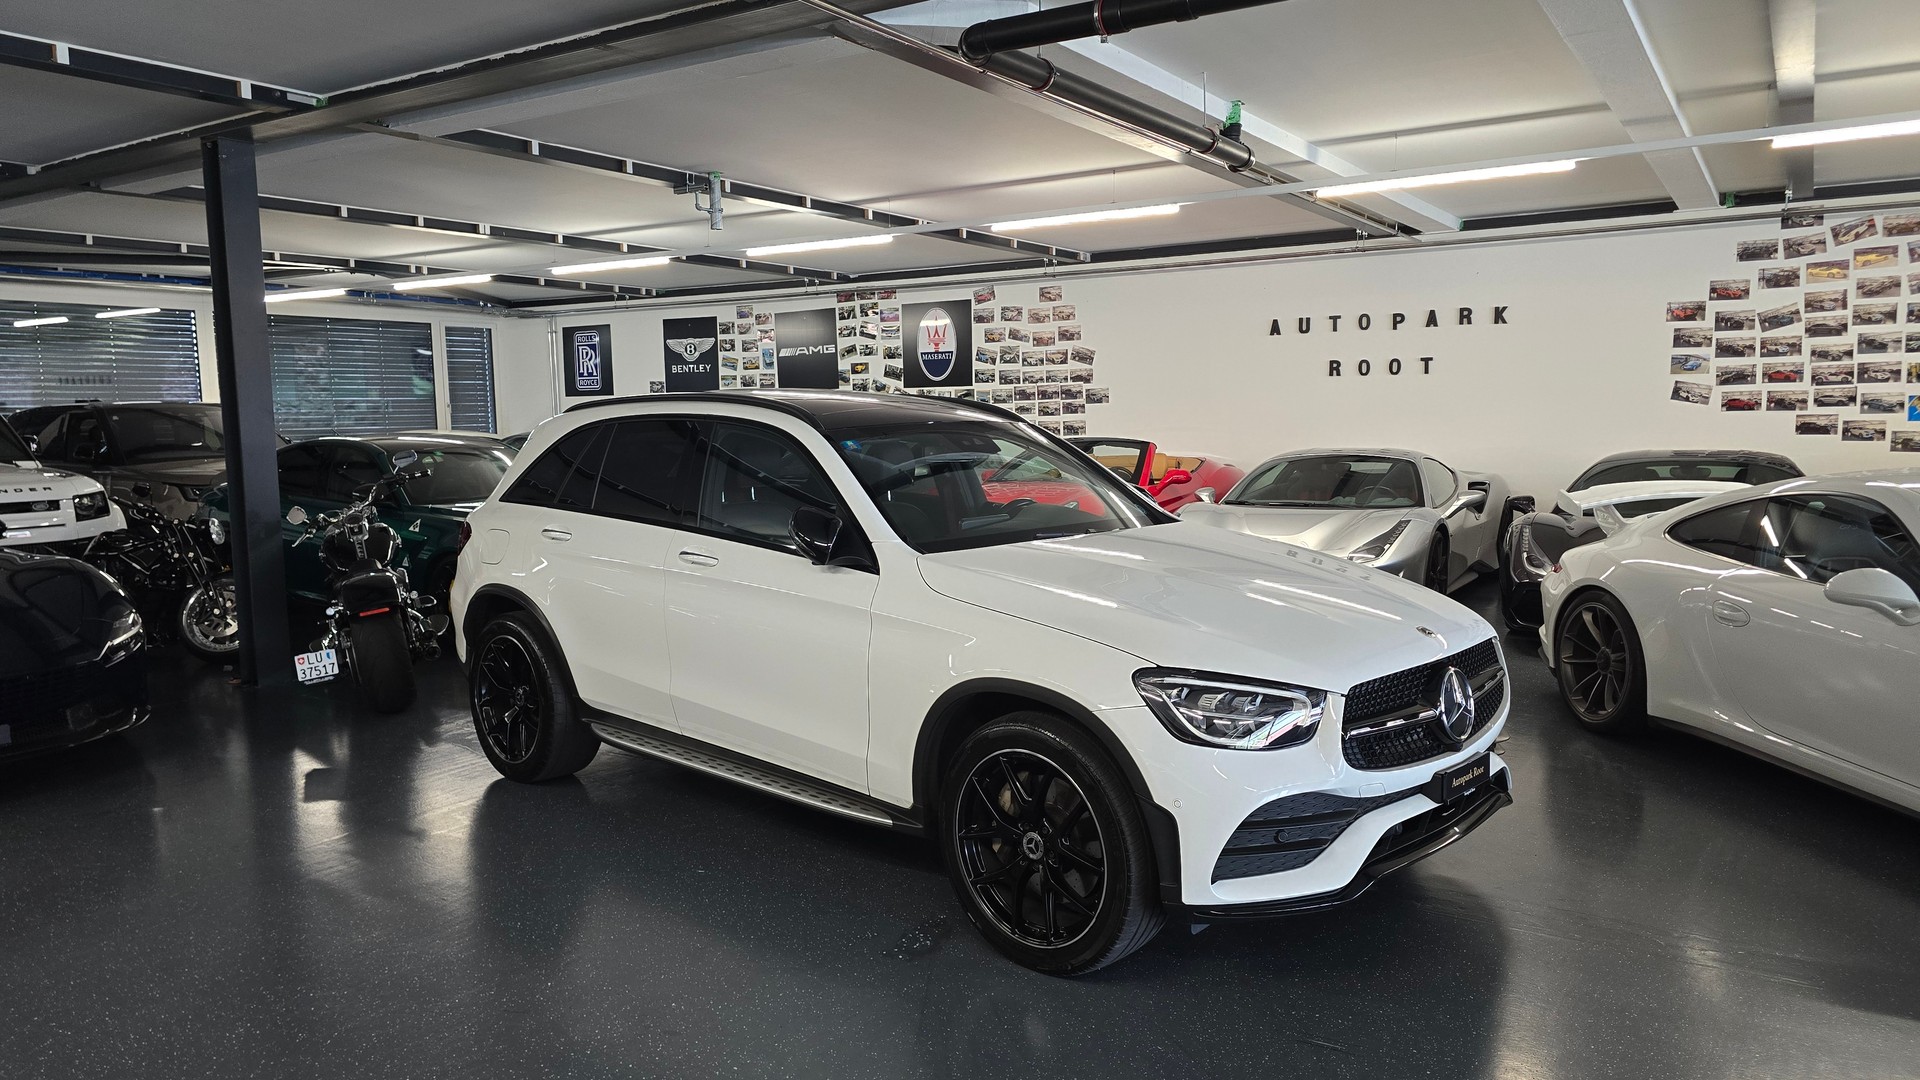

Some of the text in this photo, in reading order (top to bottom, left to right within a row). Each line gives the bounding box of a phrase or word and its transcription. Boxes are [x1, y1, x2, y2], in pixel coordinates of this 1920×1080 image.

[1269, 306, 1509, 336] AUTOPARK
[577, 335, 596, 343] ROLLS
[796, 344, 836, 356] AMG
[671, 364, 711, 373] BENTLEY
[1328, 357, 1434, 377] ROOT
[307, 653, 323, 665] LU
[300, 663, 335, 679] 37517
[1451, 766, 1484, 788] Autopark Root
